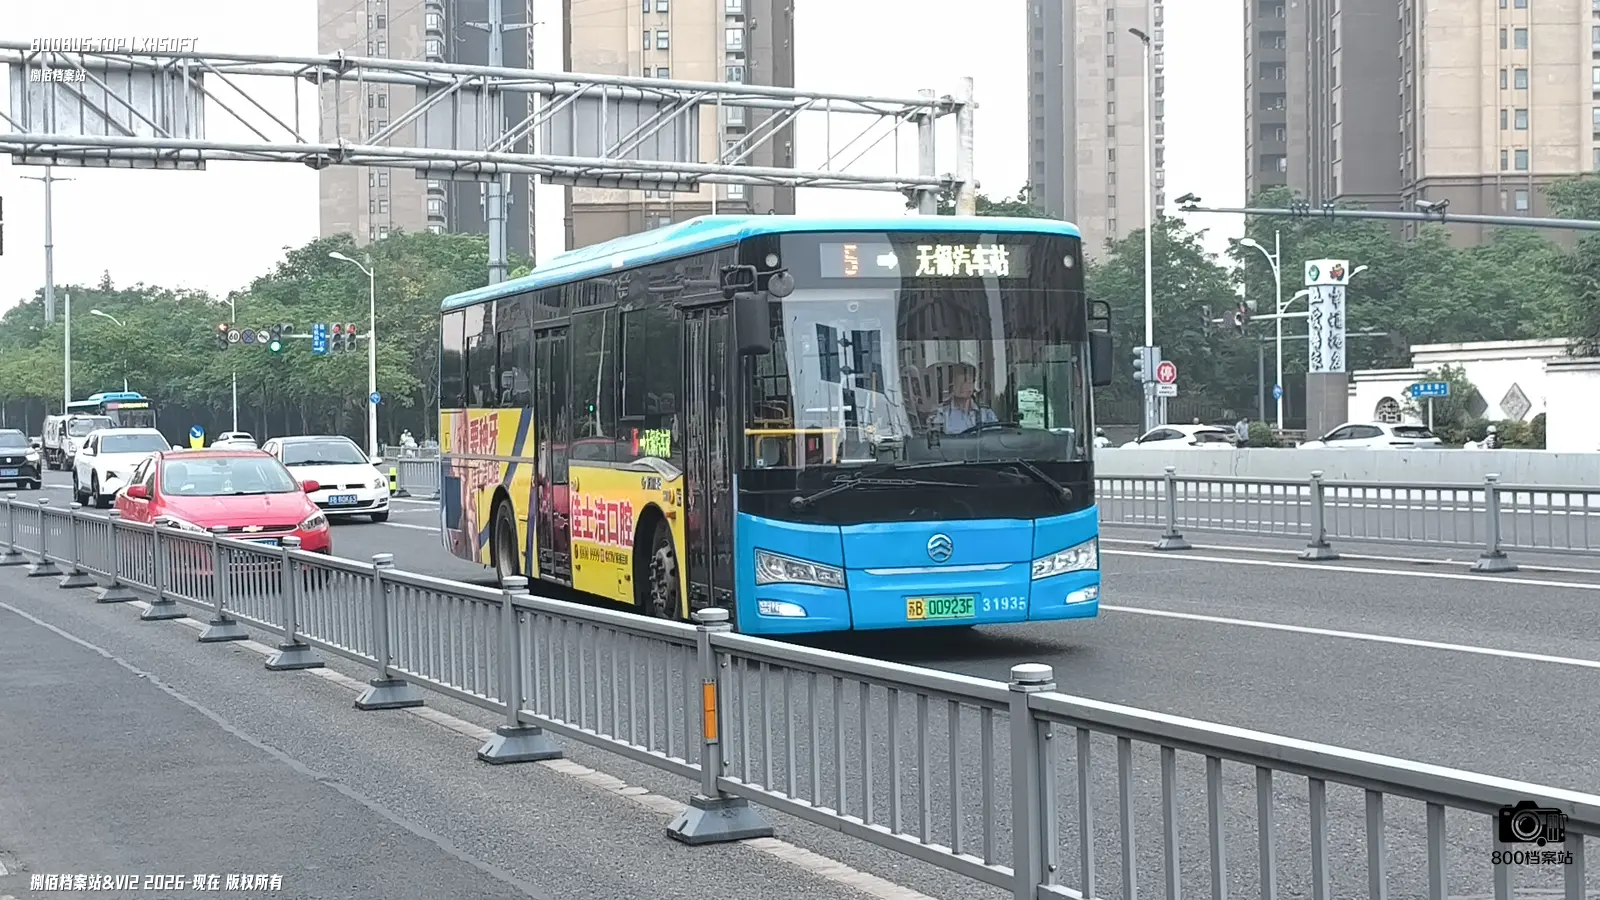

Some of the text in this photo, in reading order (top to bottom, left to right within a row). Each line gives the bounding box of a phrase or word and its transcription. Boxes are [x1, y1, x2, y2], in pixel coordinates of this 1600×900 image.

[843, 244, 859, 276] 5
[915, 243, 1010, 277] 无锡汽车站
[228, 331, 239, 341] 60
[1160, 365, 1172, 381] 停
[571, 494, 634, 547] 佳士洁口腔
[928, 598, 974, 616] 00923F
[982, 597, 1027, 612] 31935
